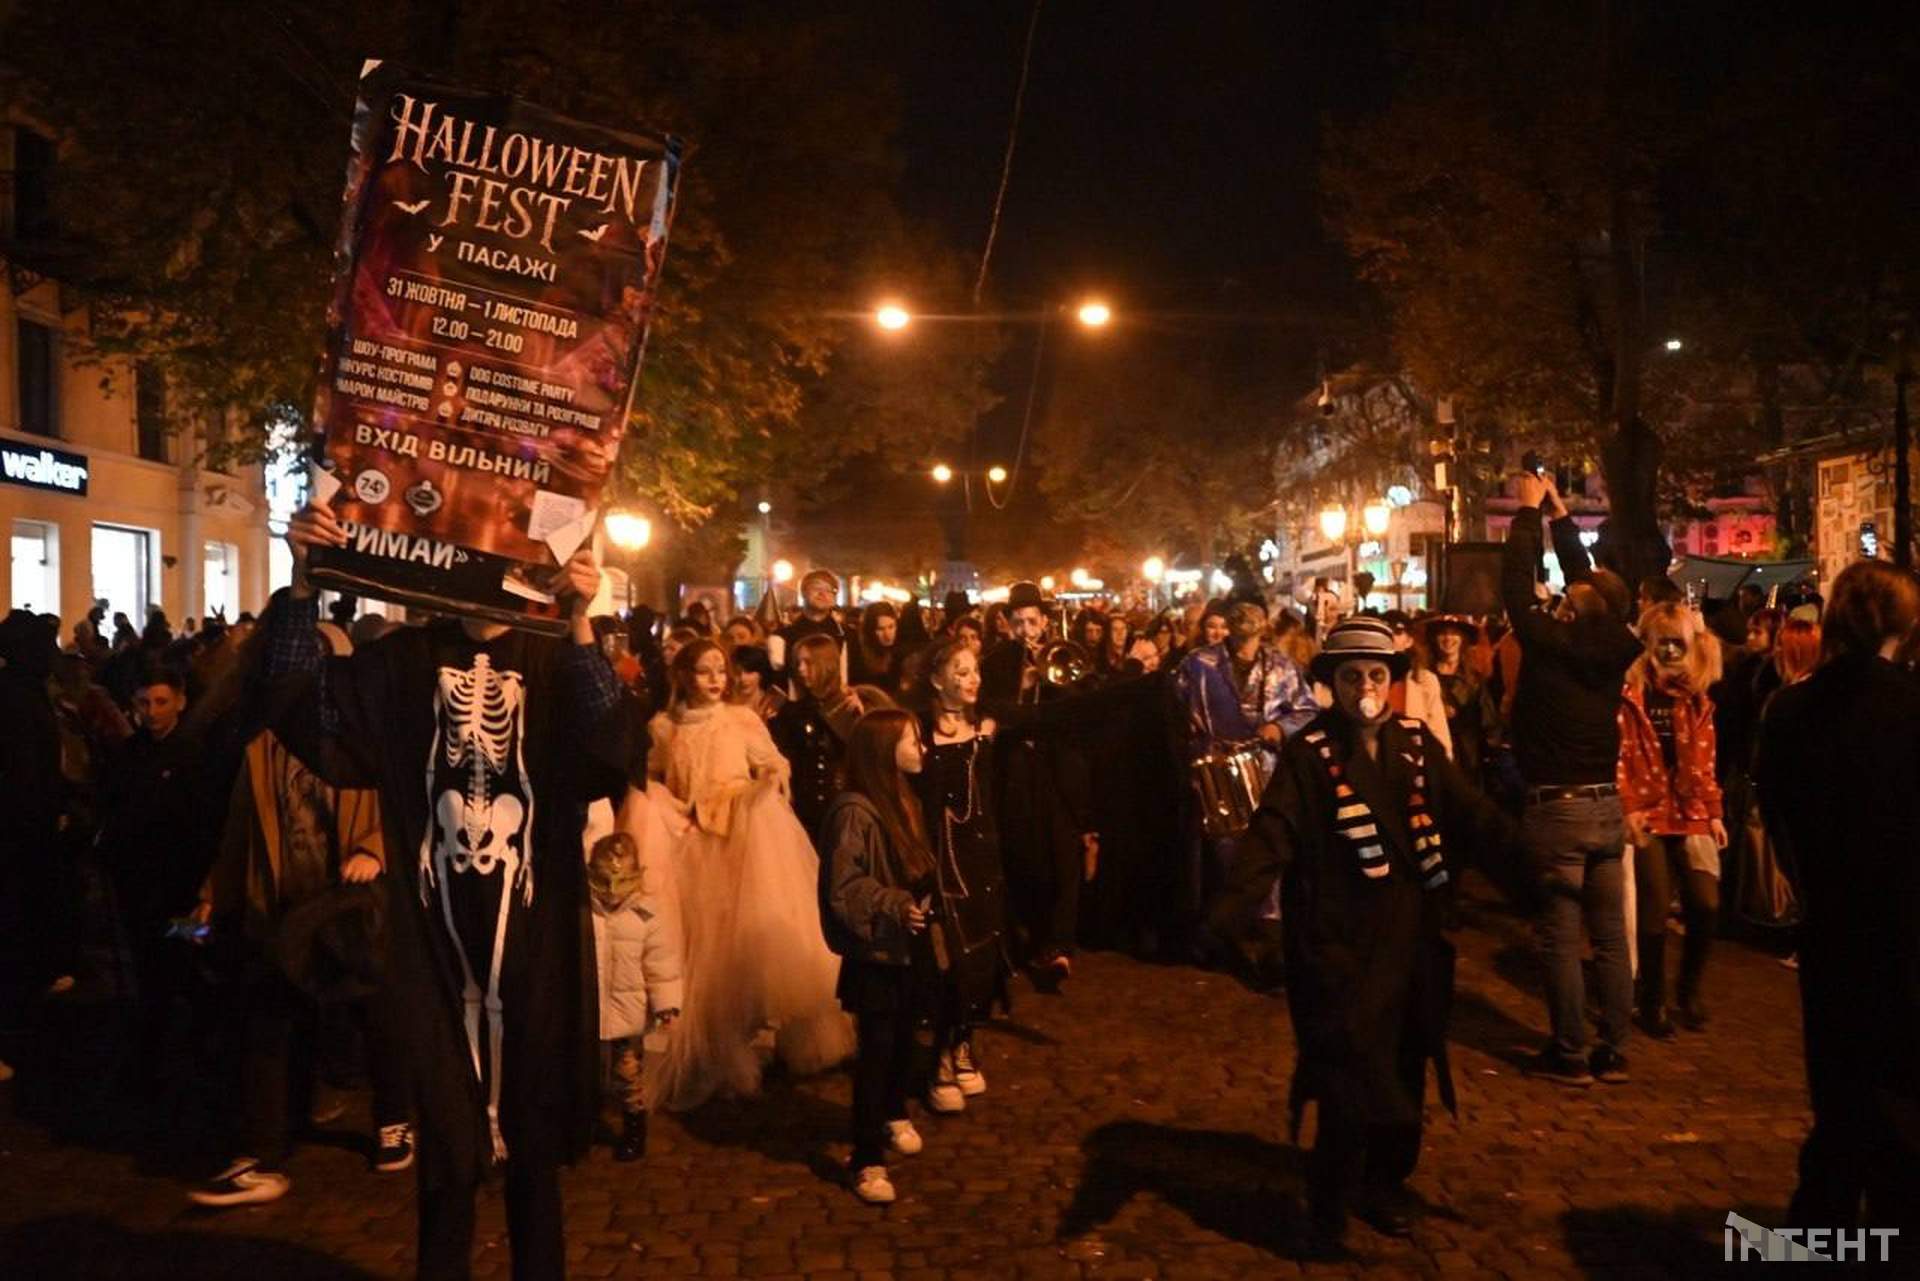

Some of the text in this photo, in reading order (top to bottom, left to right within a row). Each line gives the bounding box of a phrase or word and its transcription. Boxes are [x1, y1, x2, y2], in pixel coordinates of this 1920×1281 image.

[386, 93, 648, 223] HALLOWEEN
[437, 171, 571, 253] FEST
[427, 234, 557, 282] У ПАСАЖІ
[386, 277, 403, 296] 31
[405, 281, 466, 312] ЖОВТНЯ
[484, 301, 491, 318] 1
[492, 303, 577, 339] ЛИСТОПАДА
[353, 339, 437, 371] ШОУ-ПРОГРАМА
[432, 317, 468, 340] 12.00
[485, 329, 523, 353] 21.00
[376, 387, 430, 411] МАЙСТРІВ
[469, 366, 576, 403] DOG COSTUME PARTY
[533, 401, 546, 417] ТА
[2, 450, 88, 491] walker
[355, 423, 551, 484] ВХІД ВІЛЬНИЙ
